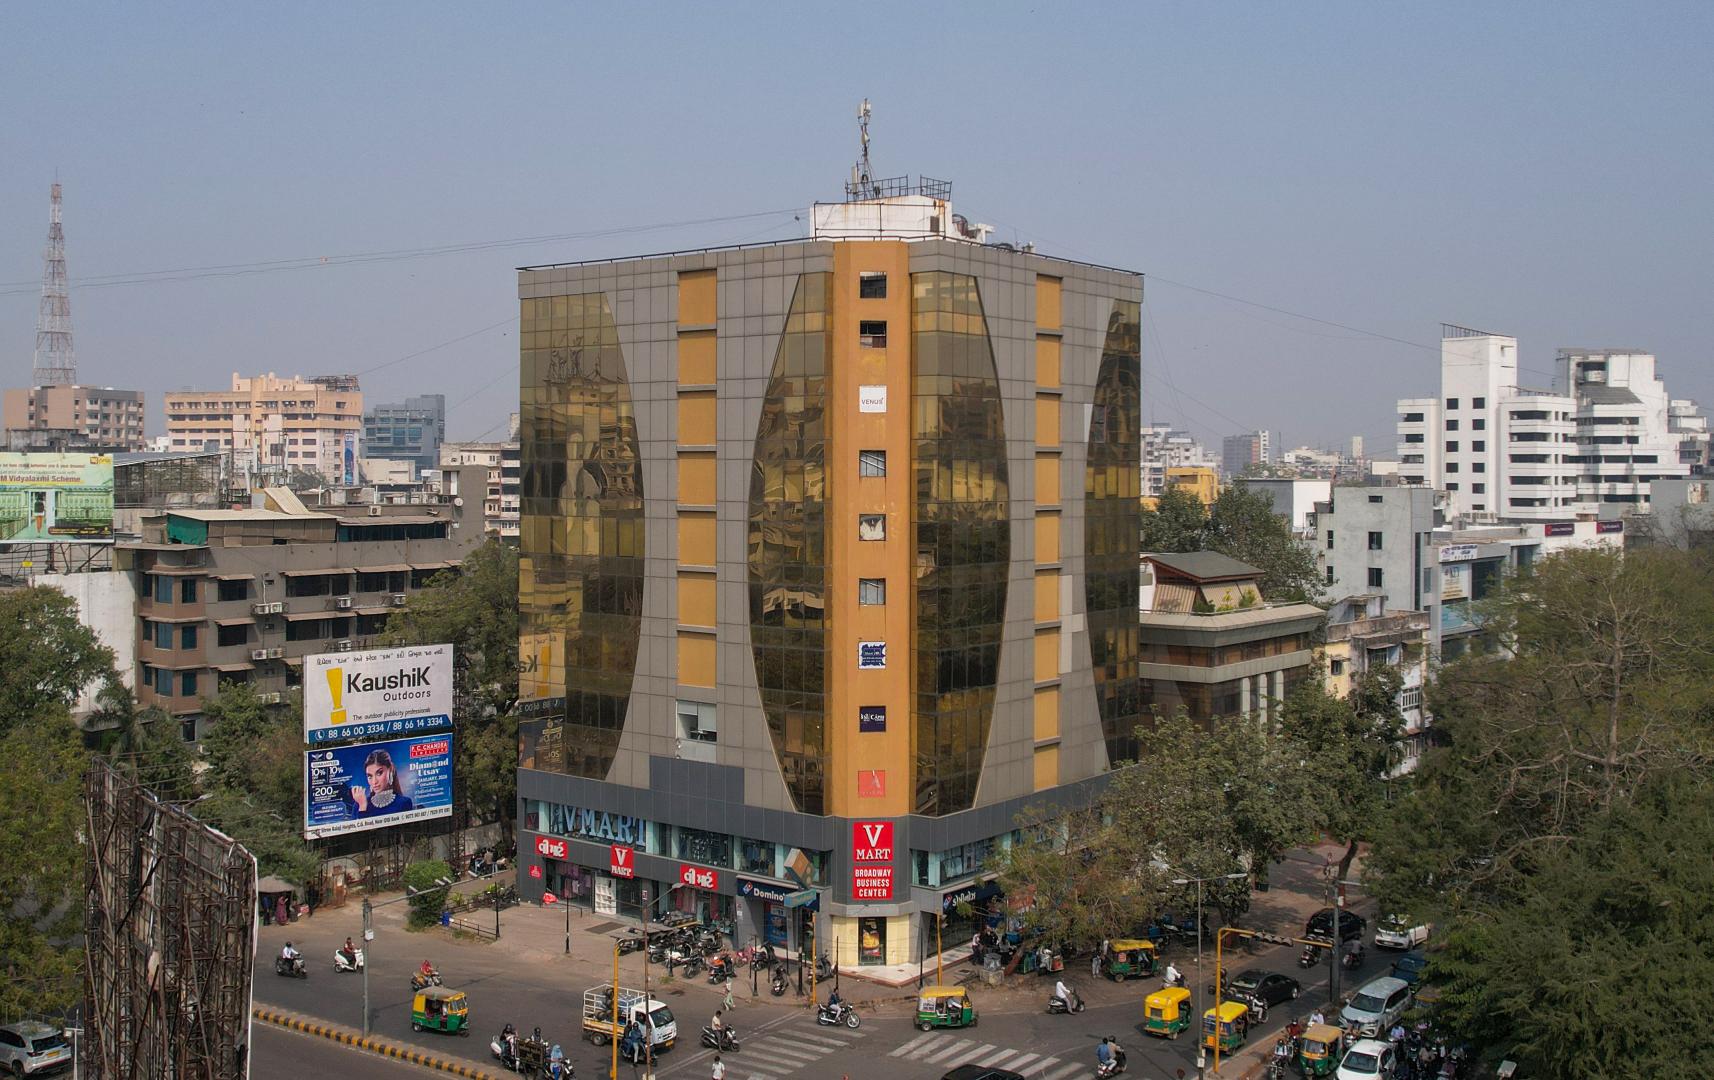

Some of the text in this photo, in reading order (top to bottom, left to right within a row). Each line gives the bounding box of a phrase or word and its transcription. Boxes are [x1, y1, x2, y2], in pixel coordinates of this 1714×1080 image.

[383, 689, 431, 702] Outdoors
[364, 712, 383, 720] outdoor
[384, 710, 404, 720] publicity
[404, 707, 431, 718] professionals
[328, 730, 338, 739] 88
[341, 728, 351, 737] 66
[354, 726, 364, 735] 00
[366, 723, 384, 734] 3334
[392, 721, 402, 731] 88
[405, 720, 414, 729] 66
[416, 719, 425, 728] 14
[426, 716, 443, 727] 3334
[422, 742, 447, 750] CHANDRA
[311, 768, 326, 776] 10%
[329, 766, 343, 775] 10%
[863, 824, 884, 848] V
[615, 848, 627, 865] V
[856, 849, 890, 860] MART
[611, 865, 631, 876] MART
[855, 869, 891, 878] BROADWAY
[856, 879, 890, 887] BUSINESS
[858, 888, 887, 897] CENTER
